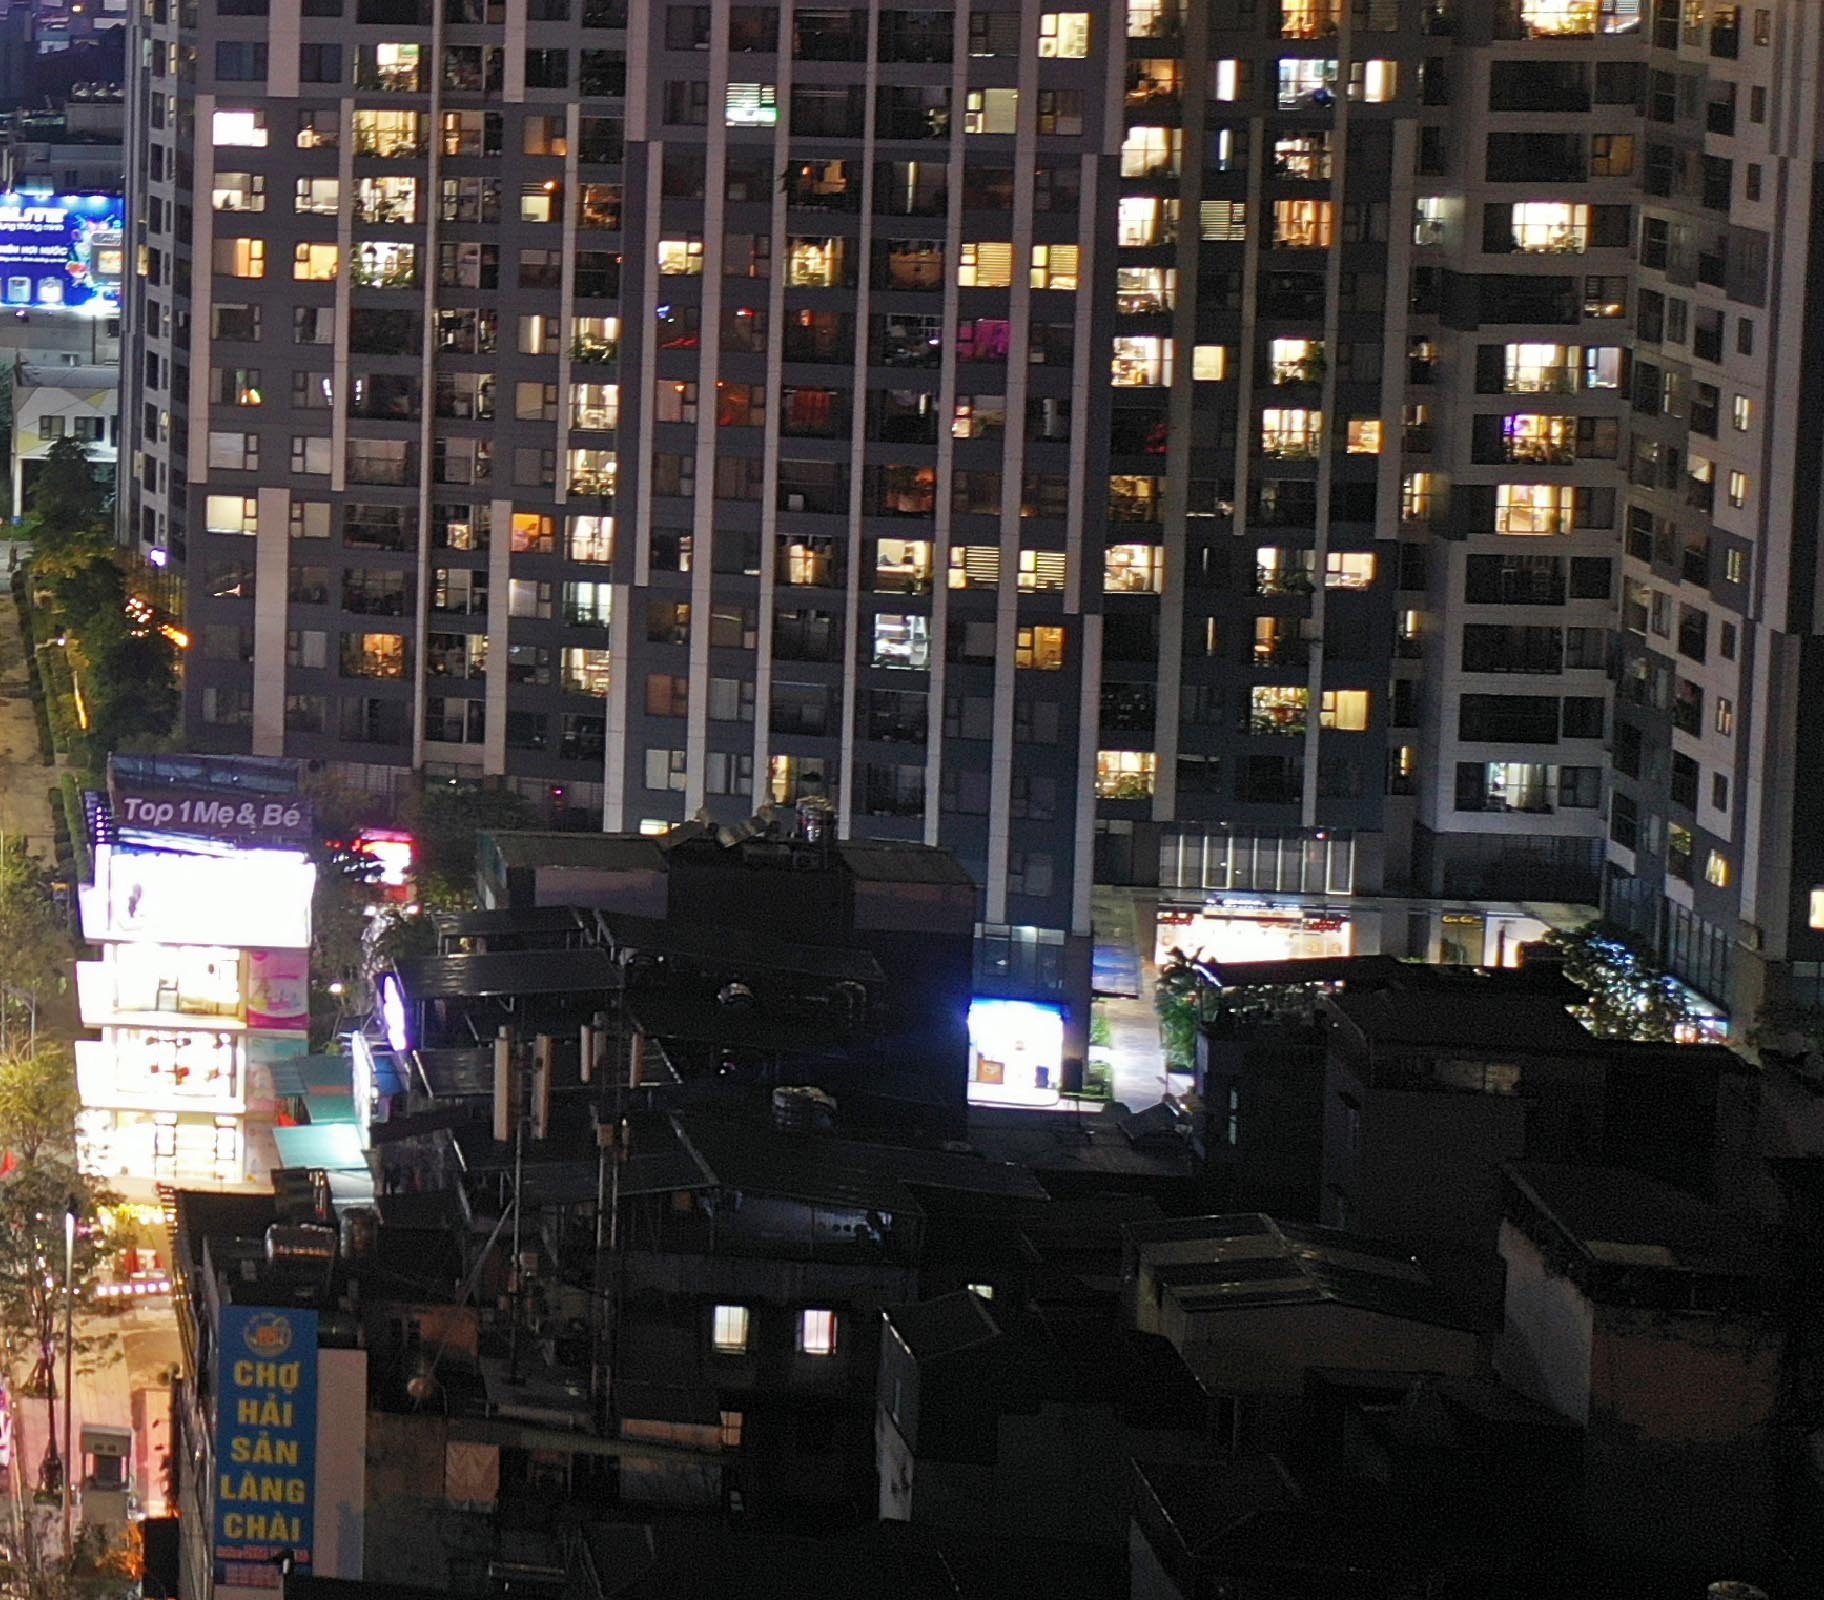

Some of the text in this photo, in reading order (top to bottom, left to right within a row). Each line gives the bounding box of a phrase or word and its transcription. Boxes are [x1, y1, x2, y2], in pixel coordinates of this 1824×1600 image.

[124, 798, 173, 826] Top
[263, 803, 301, 827] Bé
[233, 1359, 301, 1394] CHỢ
[238, 1392, 293, 1425] HẢI
[230, 1432, 300, 1466] SẢN
[220, 1470, 306, 1504] LÀNG
[223, 1511, 301, 1541] CHÀI
